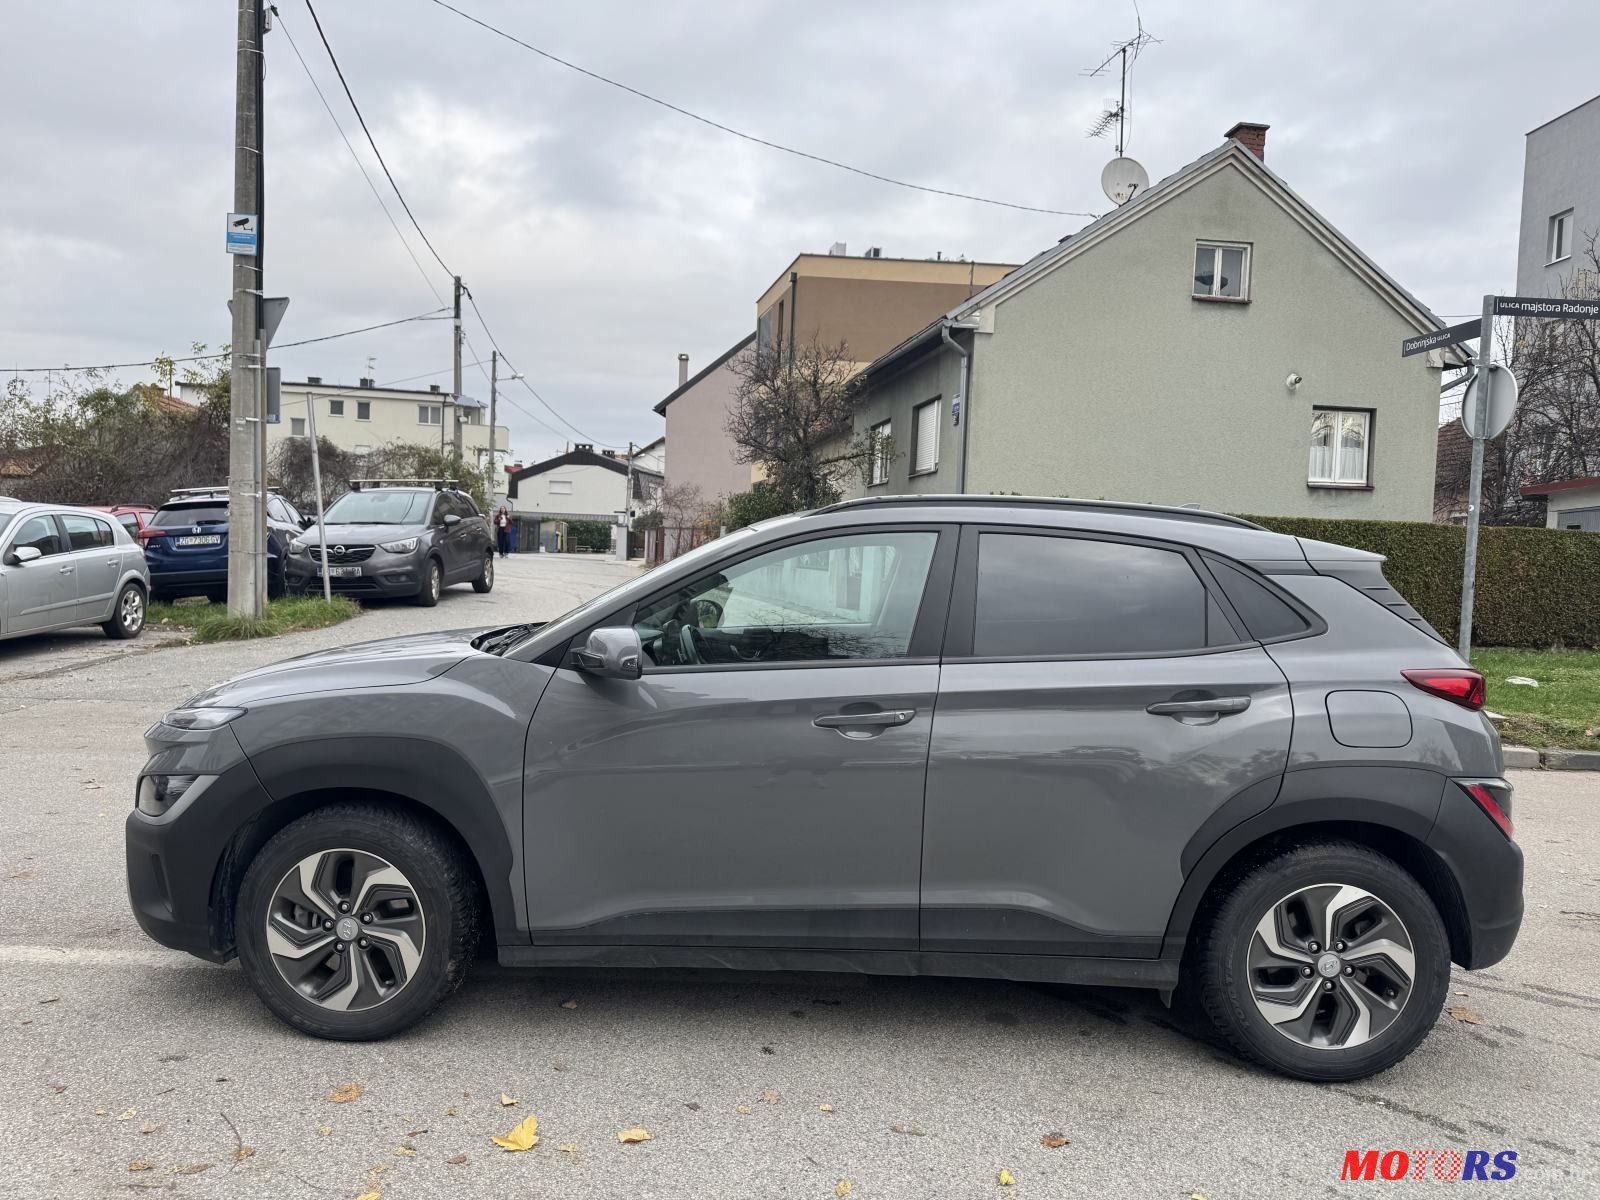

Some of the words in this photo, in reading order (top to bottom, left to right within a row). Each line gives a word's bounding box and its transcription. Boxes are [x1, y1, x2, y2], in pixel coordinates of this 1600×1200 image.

[1521, 302, 1561, 313] majstora
[1562, 303, 1599, 316] Radonje
[1406, 337, 1436, 351] Dobrinjska
[1436, 333, 1451, 341] ULICA
